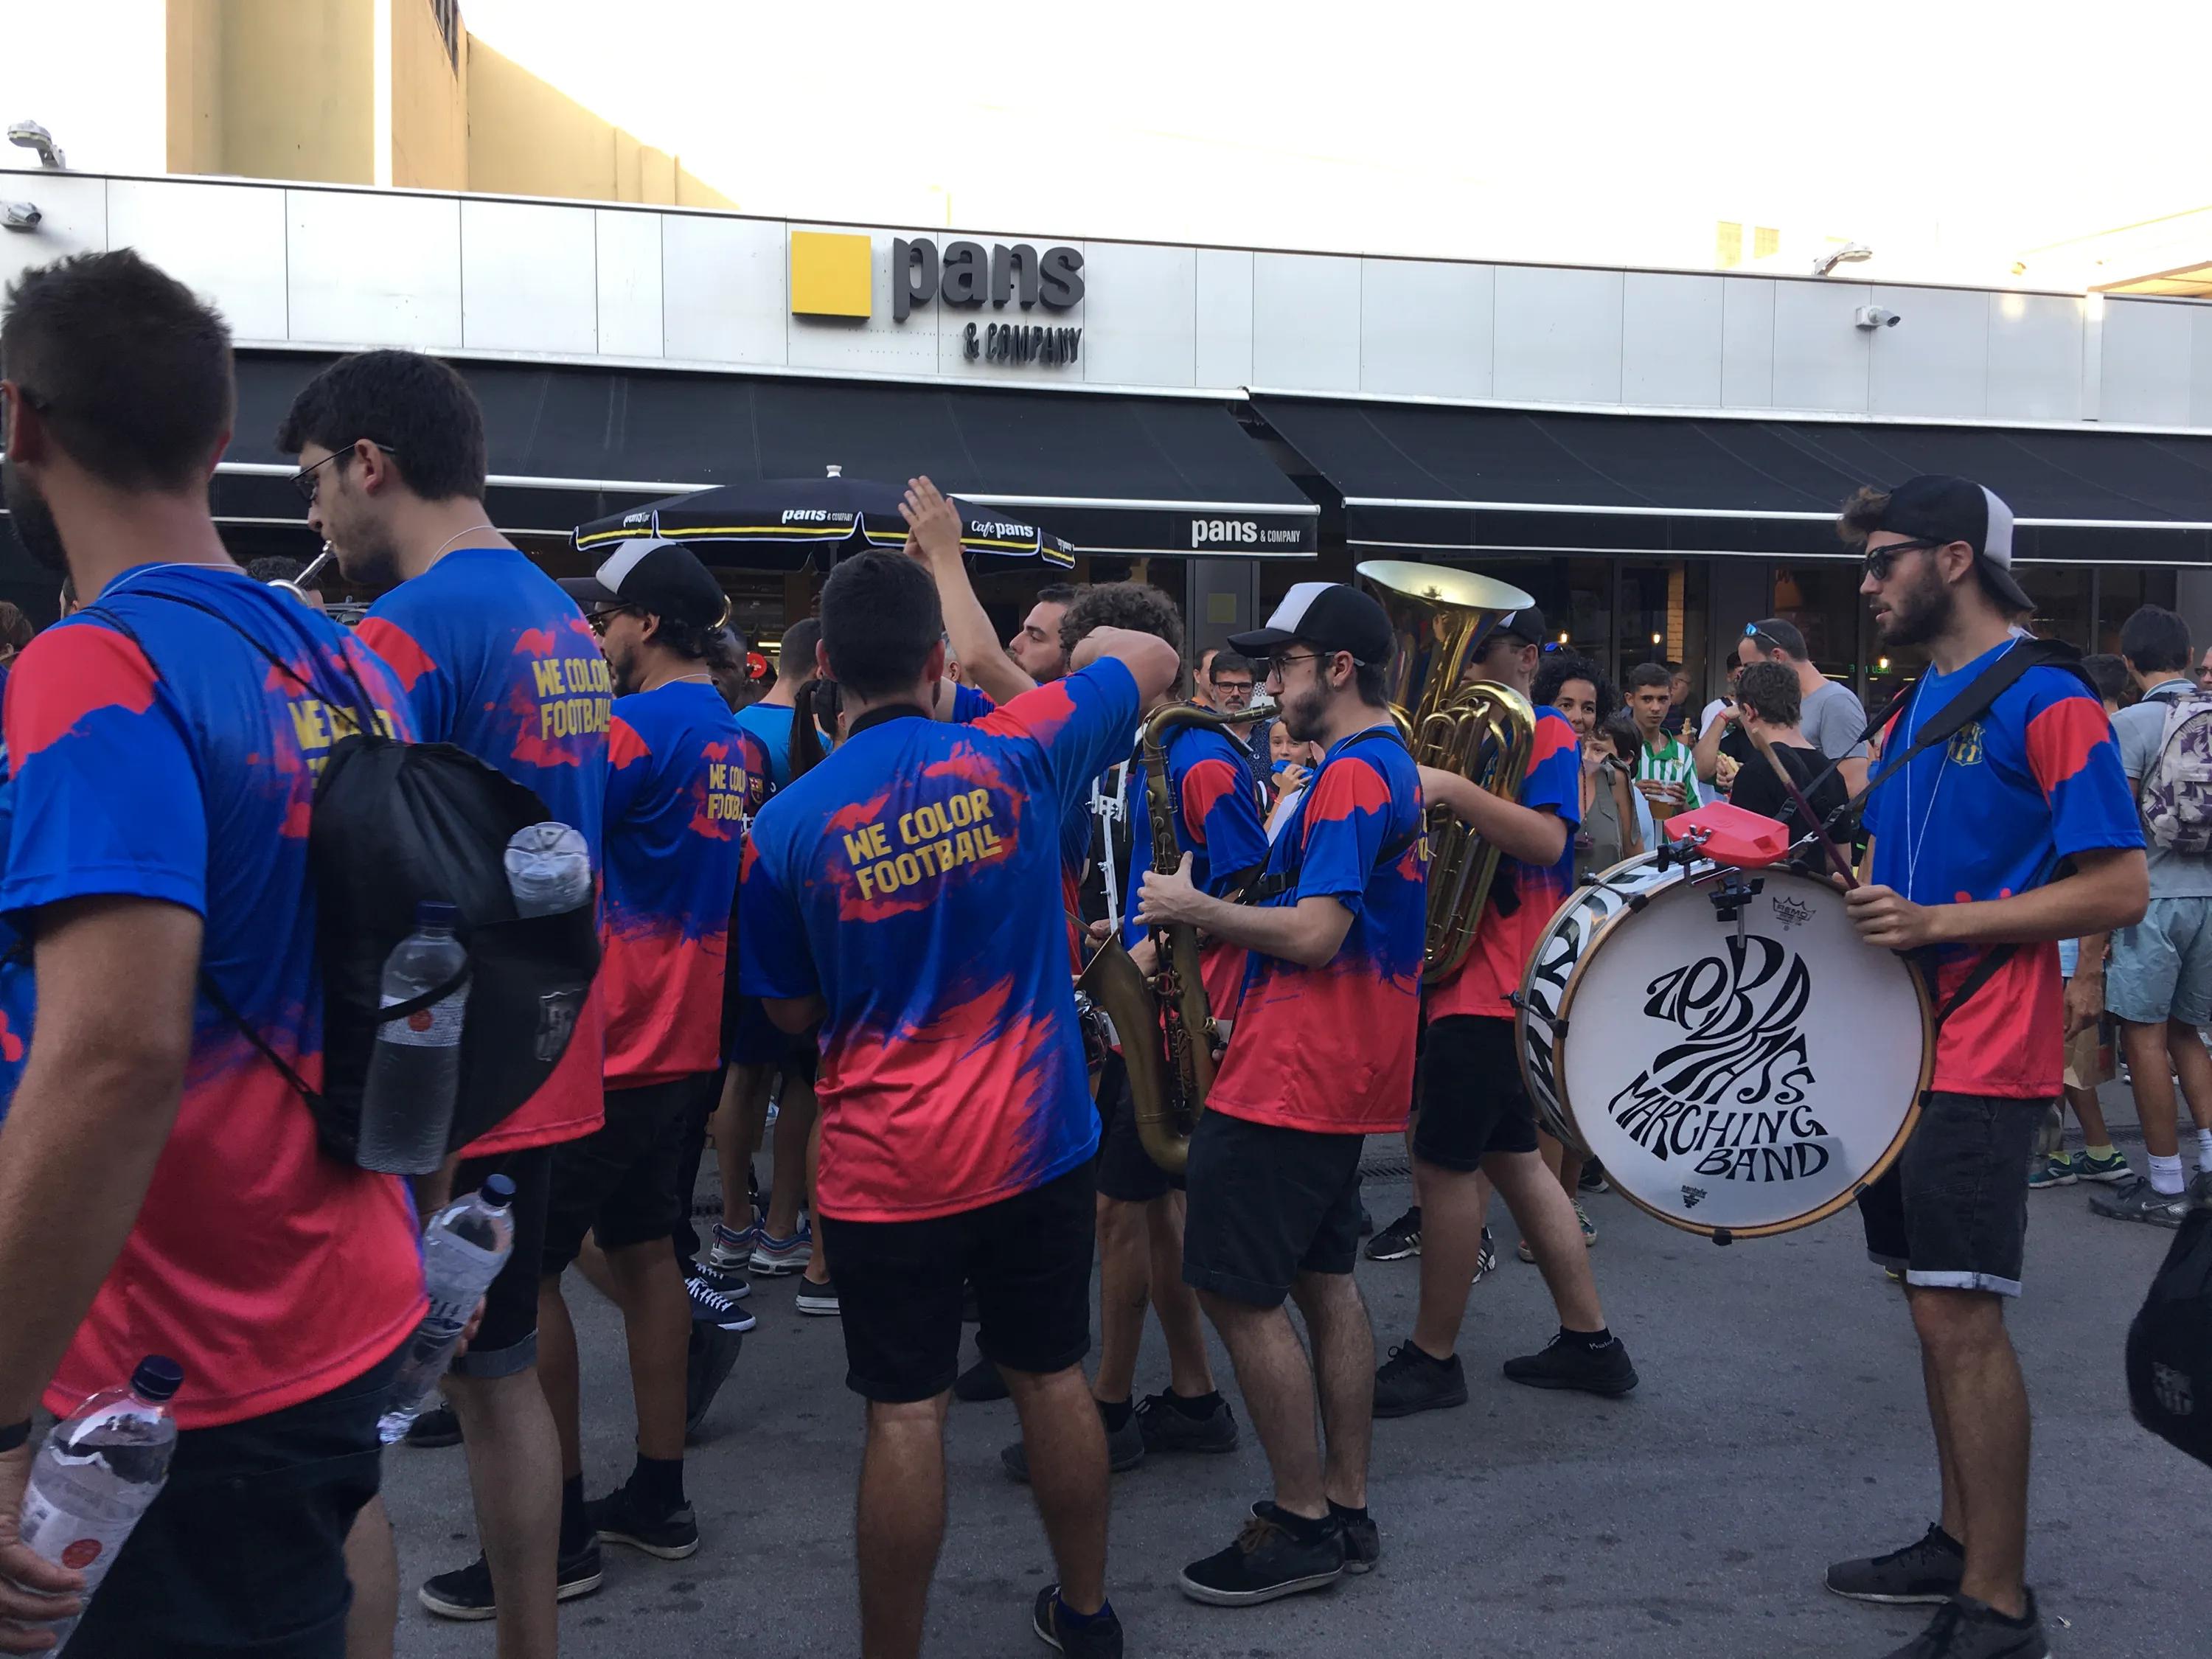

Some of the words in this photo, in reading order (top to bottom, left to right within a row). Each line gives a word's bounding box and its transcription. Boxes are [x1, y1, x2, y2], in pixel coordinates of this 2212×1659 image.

[892, 237, 1085, 323] pans
[963, 322, 979, 359] &
[985, 322, 1082, 364] COMPANY
[782, 509, 827, 524] pans
[832, 512, 853, 521] COMPANY
[995, 522, 1034, 539] pans
[1192, 520, 1257, 548] pans
[1260, 530, 1266, 542] &
[1267, 530, 1301, 543] COMPANY
[532, 658, 566, 698] WE
[709, 763, 727, 790] WE
[843, 822, 892, 866] WE
[898, 788, 994, 845] COLOR
[855, 824, 1003, 901] FOOTBALL
[1776, 904, 1808, 919] REMO
[1607, 1069, 1829, 1162] MARCHING
[1694, 1142, 1829, 1182] BAND
